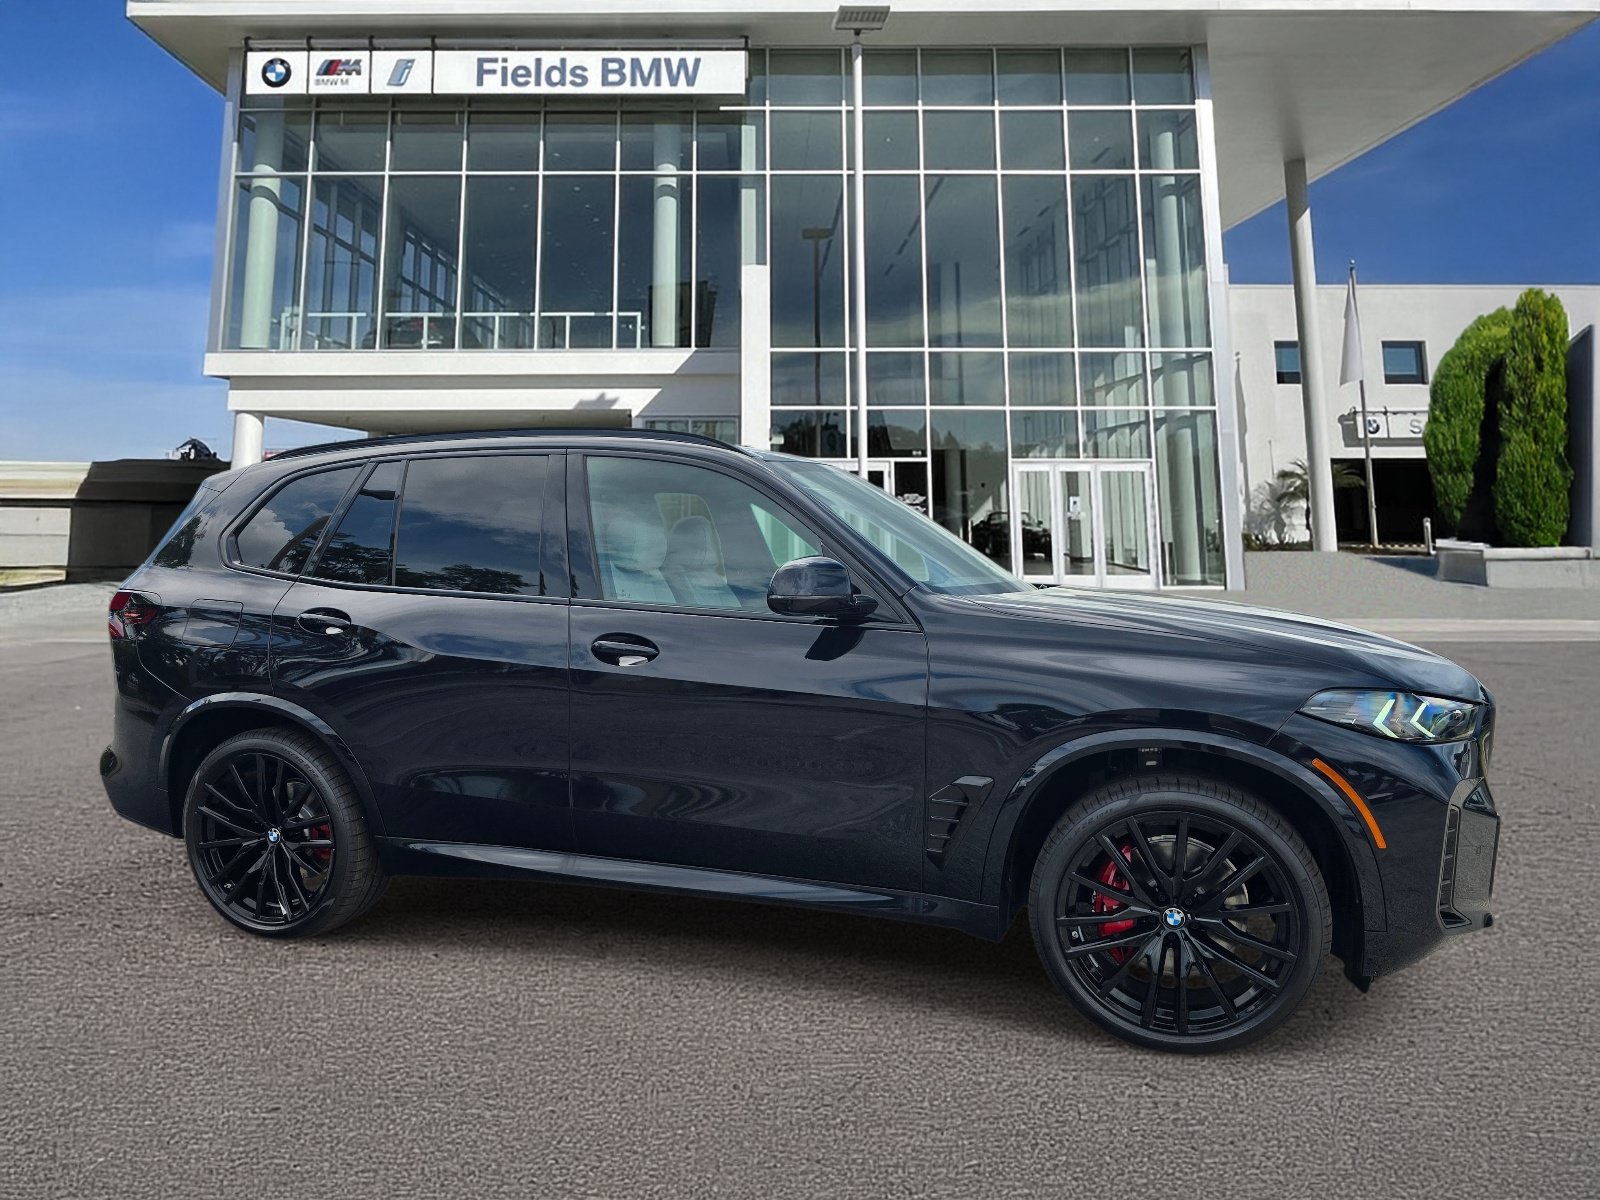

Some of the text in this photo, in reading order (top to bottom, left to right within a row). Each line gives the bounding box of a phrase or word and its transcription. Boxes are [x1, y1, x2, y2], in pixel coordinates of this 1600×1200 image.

[476, 57, 701, 87] Fields BMW
[1409, 419, 1423, 434] S
